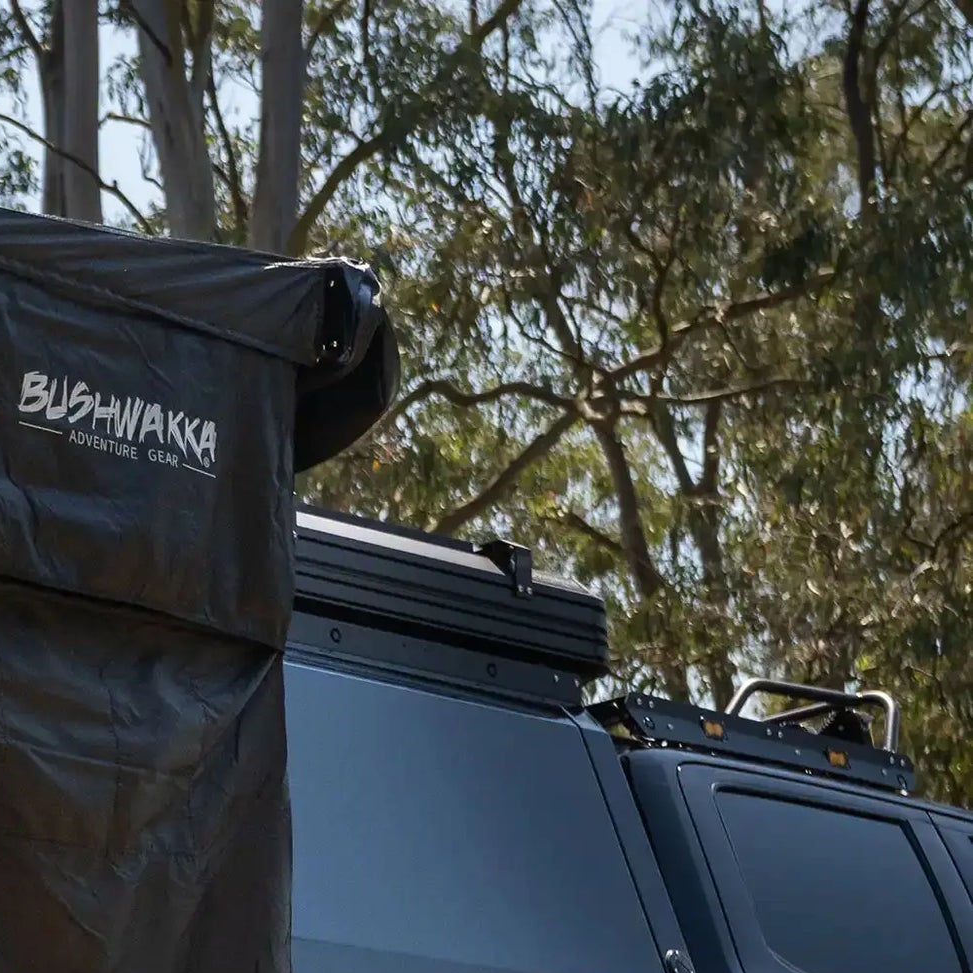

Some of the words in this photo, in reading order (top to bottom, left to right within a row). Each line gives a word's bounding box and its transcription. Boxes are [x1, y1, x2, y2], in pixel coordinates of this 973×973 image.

[18, 371, 217, 465] BUSHWAKKA
[69, 429, 138, 460] ADVENTURE
[147, 449, 179, 468] GEAR
